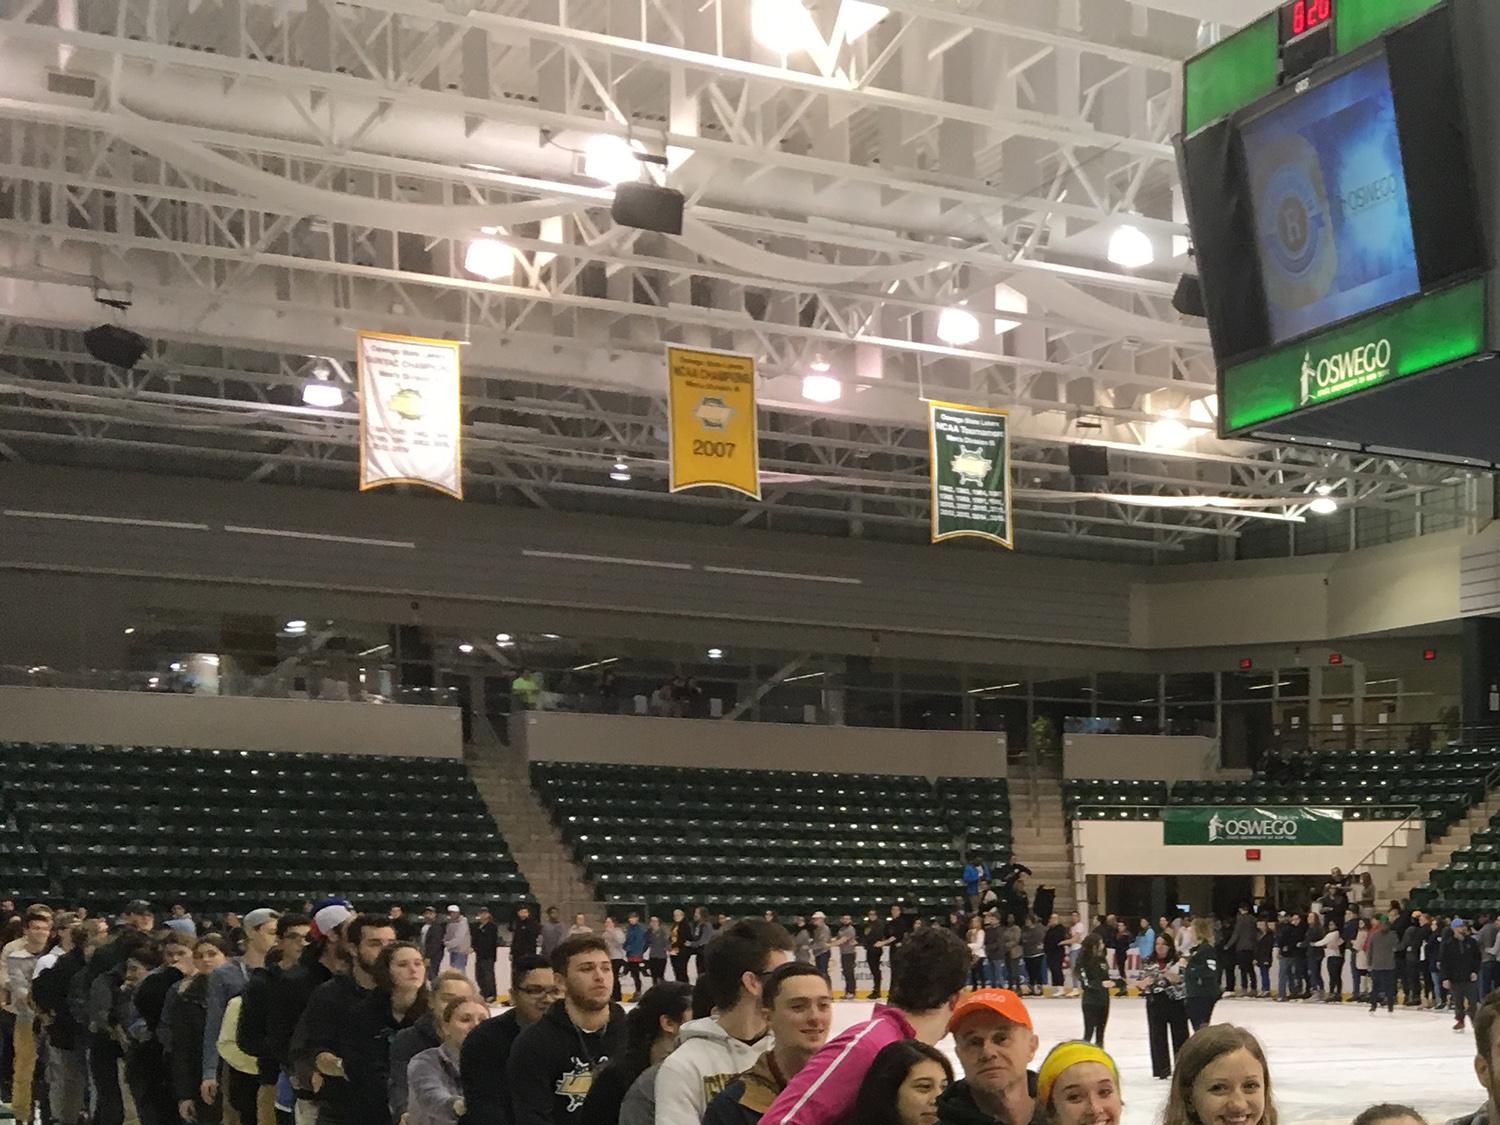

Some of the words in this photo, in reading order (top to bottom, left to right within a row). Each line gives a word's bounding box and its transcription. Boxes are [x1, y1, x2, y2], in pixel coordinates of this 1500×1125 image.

[1316, 339, 1391, 388] OSWEGO
[936, 421, 960, 433] NCAA
[692, 439, 736, 459] 2007
[1225, 820, 1297, 836] OSWEGO
